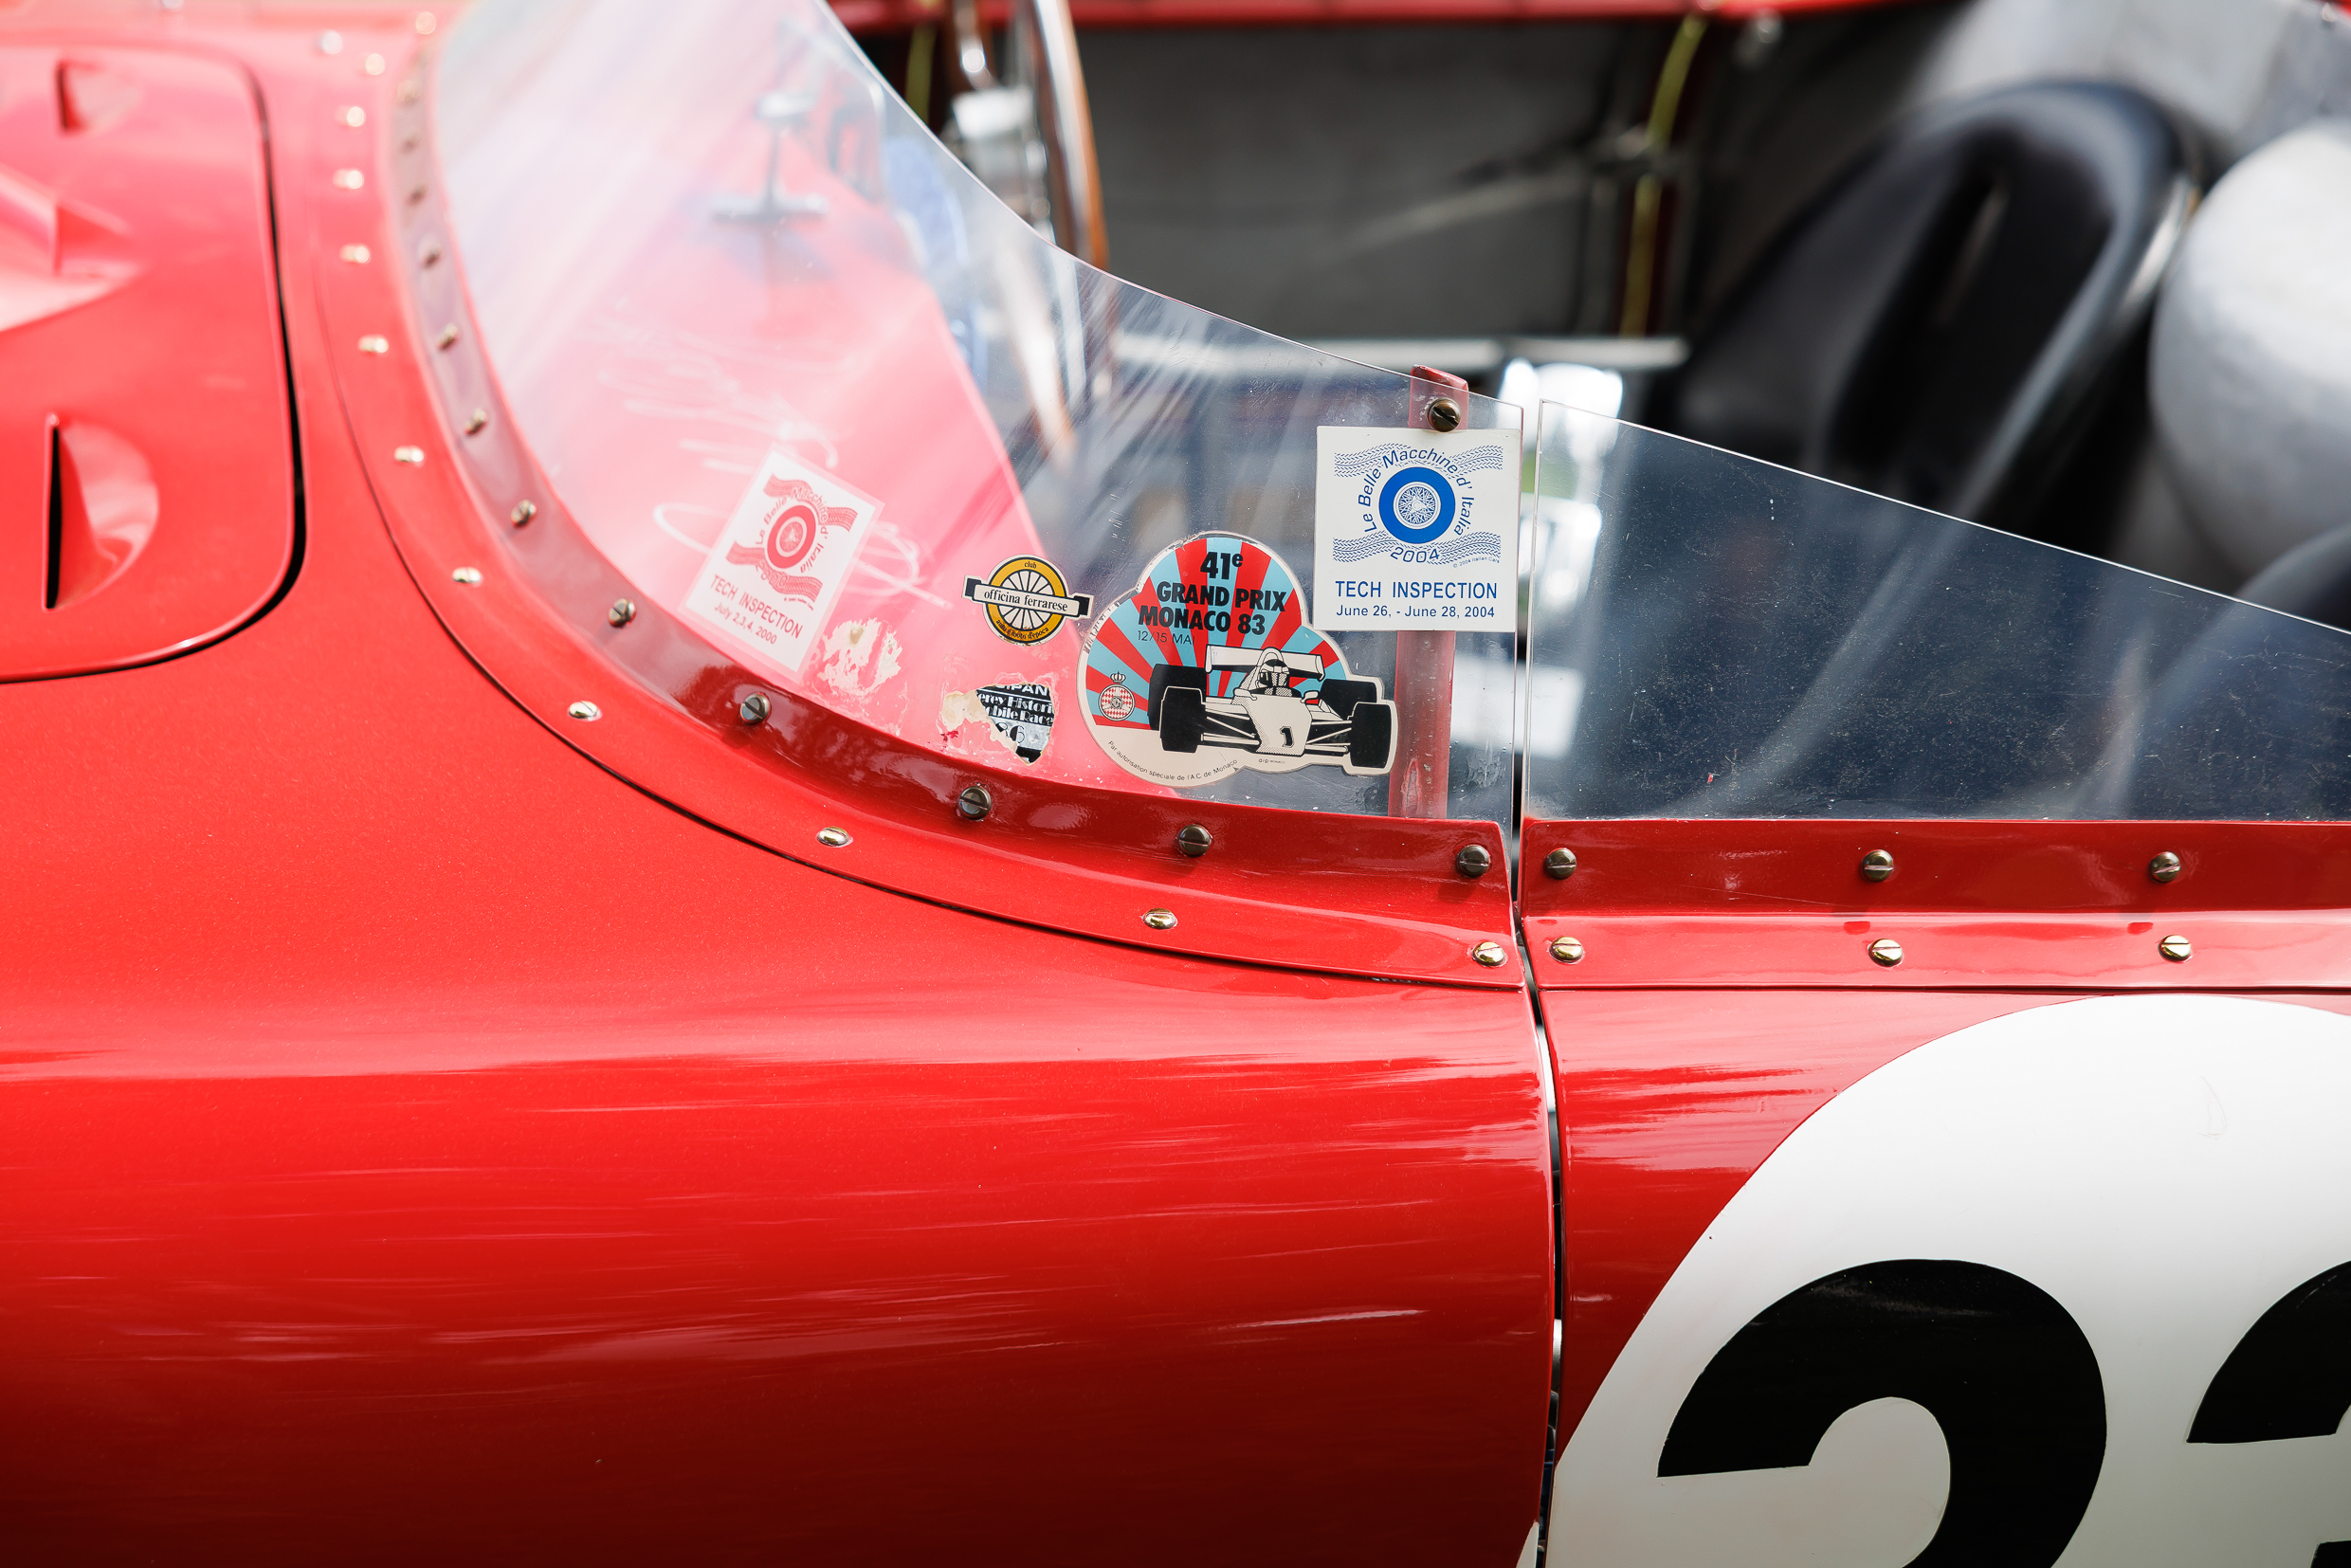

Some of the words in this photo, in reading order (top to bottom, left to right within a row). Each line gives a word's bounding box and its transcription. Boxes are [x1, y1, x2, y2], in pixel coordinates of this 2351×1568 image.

[1382, 447, 1459, 474] Macchine
[1358, 468, 1382, 507] Belle
[764, 497, 787, 525] Belle
[791, 486, 829, 523] Macchine
[1453, 496, 1475, 536] Italia
[1363, 513, 1377, 533] Le
[800, 542, 824, 574] Italia
[1390, 546, 1440, 563] 2004
[984, 590, 1021, 604] officina
[1024, 594, 1068, 611] ferrarese
[1157, 580, 1230, 607] GRAND
[1234, 588, 1287, 612] PRIX
[1335, 580, 1381, 598] TECH
[1393, 581, 1497, 599] INSPECTION
[710, 574, 738, 601] TECH
[738, 592, 803, 639] INSPECTION
[1138, 605, 1231, 632] MONACO
[1238, 613, 1266, 635] 83
[1336, 605, 1369, 617] June
[1373, 605, 1392, 618] 26,
[1404, 606, 1437, 617] June
[1441, 606, 1460, 619] 28,
[1465, 607, 1495, 618] 2004
[714, 602, 733, 620] July
[755, 626, 777, 645] 2000
[1138, 629, 1168, 644] 12/15
[1172, 633, 1195, 646] MAI
[1280, 725, 1294, 748] 1
[1107, 740, 1118, 751] Par
[1212, 759, 1238, 774] Monaco
